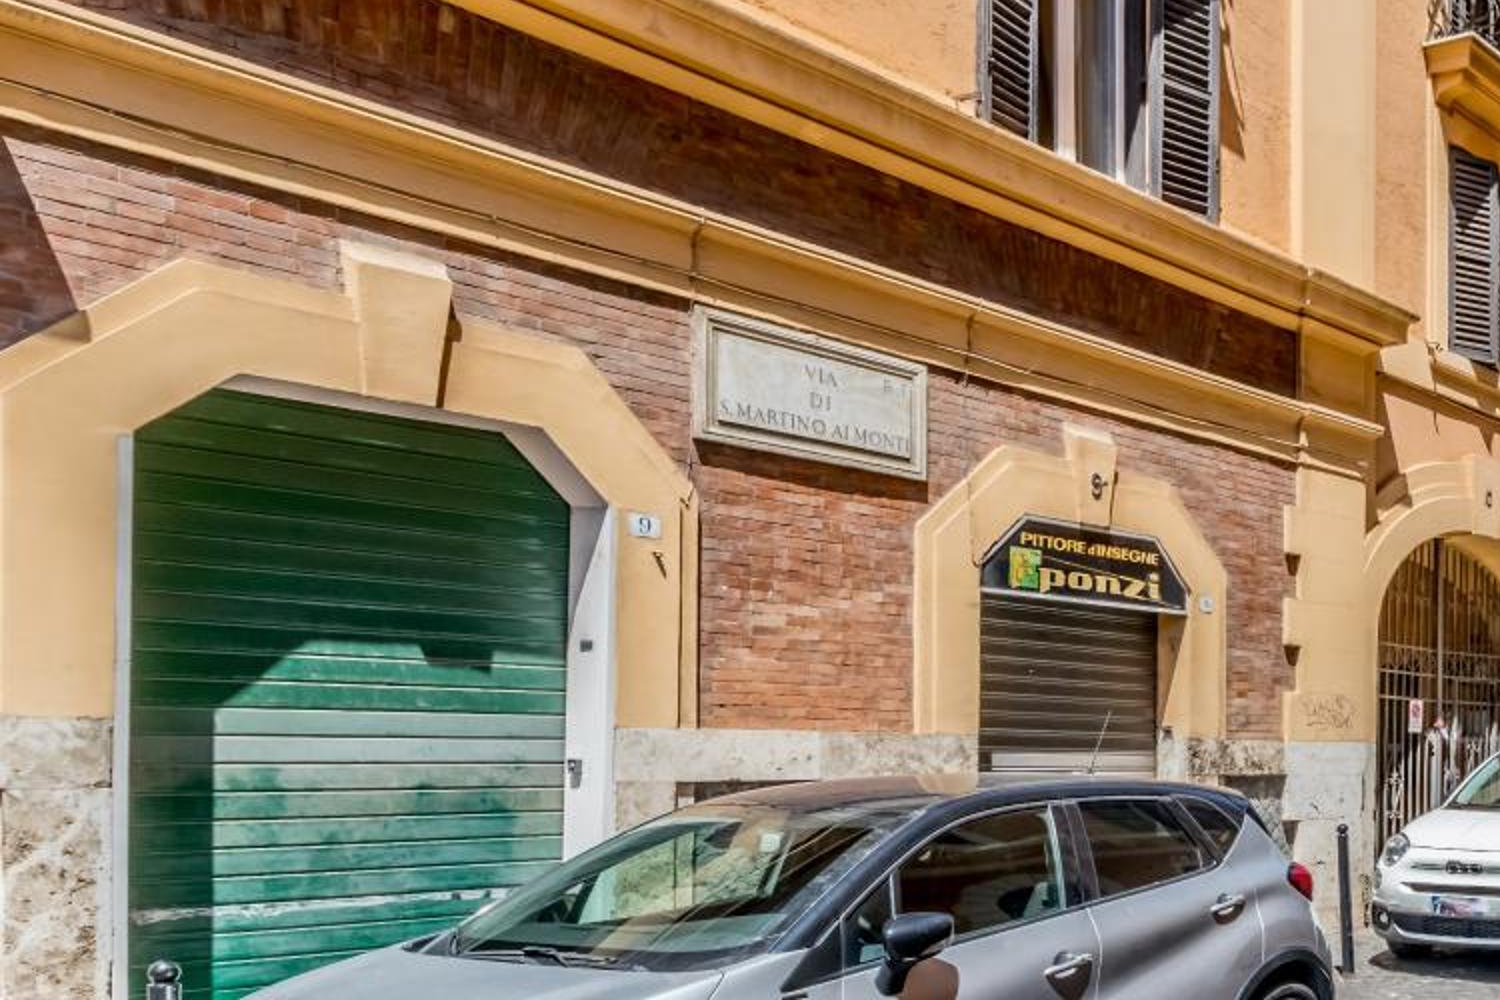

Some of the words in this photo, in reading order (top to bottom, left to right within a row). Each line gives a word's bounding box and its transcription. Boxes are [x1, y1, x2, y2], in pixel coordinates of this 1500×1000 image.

[803, 364, 838, 388] VIA
[809, 391, 831, 411] DI
[737, 404, 827, 434] MARTINO
[853, 428, 910, 454] MONTI
[639, 517, 652, 535] 9
[1020, 532, 1087, 555] PITTORE
[1038, 567, 1161, 600] ponzi
